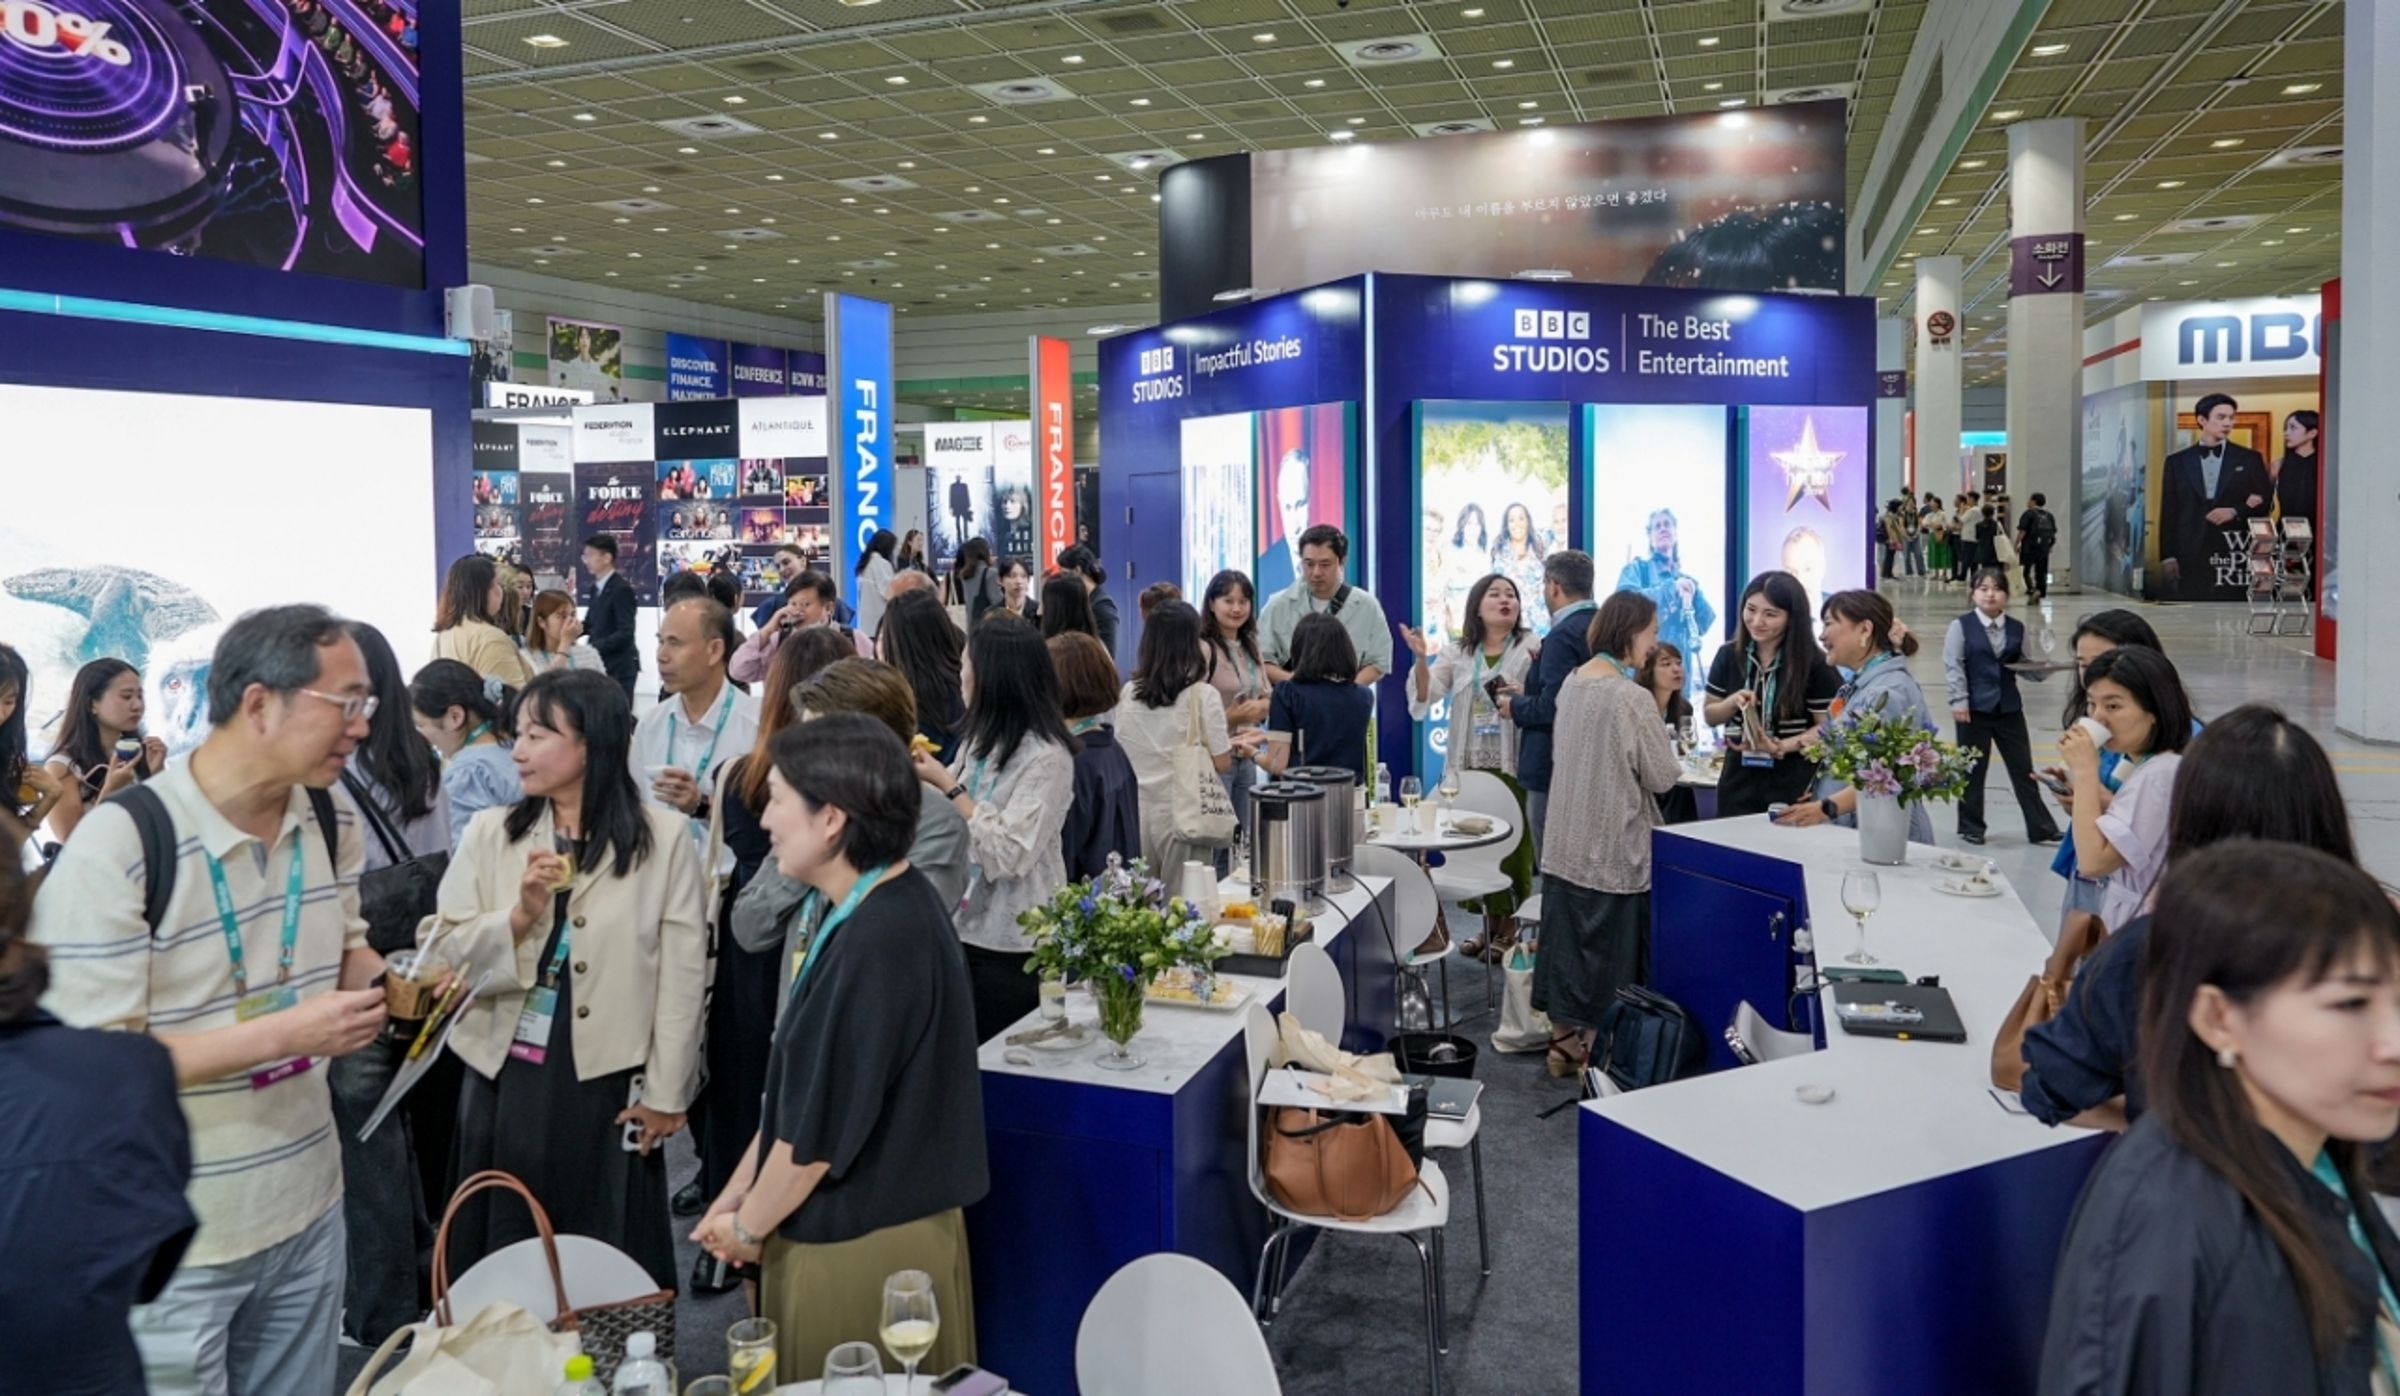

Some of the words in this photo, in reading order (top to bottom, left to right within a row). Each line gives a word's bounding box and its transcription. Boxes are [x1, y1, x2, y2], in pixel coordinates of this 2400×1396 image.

[0, 1, 132, 66] 0%
[1415, 208, 1454, 219] 아무도
[1458, 207, 1472, 218] 내
[1476, 202, 1514, 216] 이름을
[1520, 198, 1560, 213] 부르지
[1565, 193, 1620, 210] 않았으면
[1625, 188, 1668, 206] 좋겠다
[1517, 311, 1588, 337] BBC
[1638, 313, 1679, 339] The
[1684, 315, 1731, 341] Best
[2178, 311, 2321, 365] MB
[670, 356, 719, 373] DISCOVER.
[1195, 343, 1251, 378] Impactful
[1253, 335, 1302, 364] Stories
[1493, 344, 1611, 373] STUDIOS
[1638, 350, 1790, 378] Entertainment
[734, 364, 784, 385] CONFERENCE
[1132, 374, 1184, 404] STUDIOS
[662, 424, 731, 436] ELEPHANT
[751, 420, 814, 432] ATLANTIQUE
[855, 378, 879, 553] FRANC
[588, 486, 642, 500] FORCE
